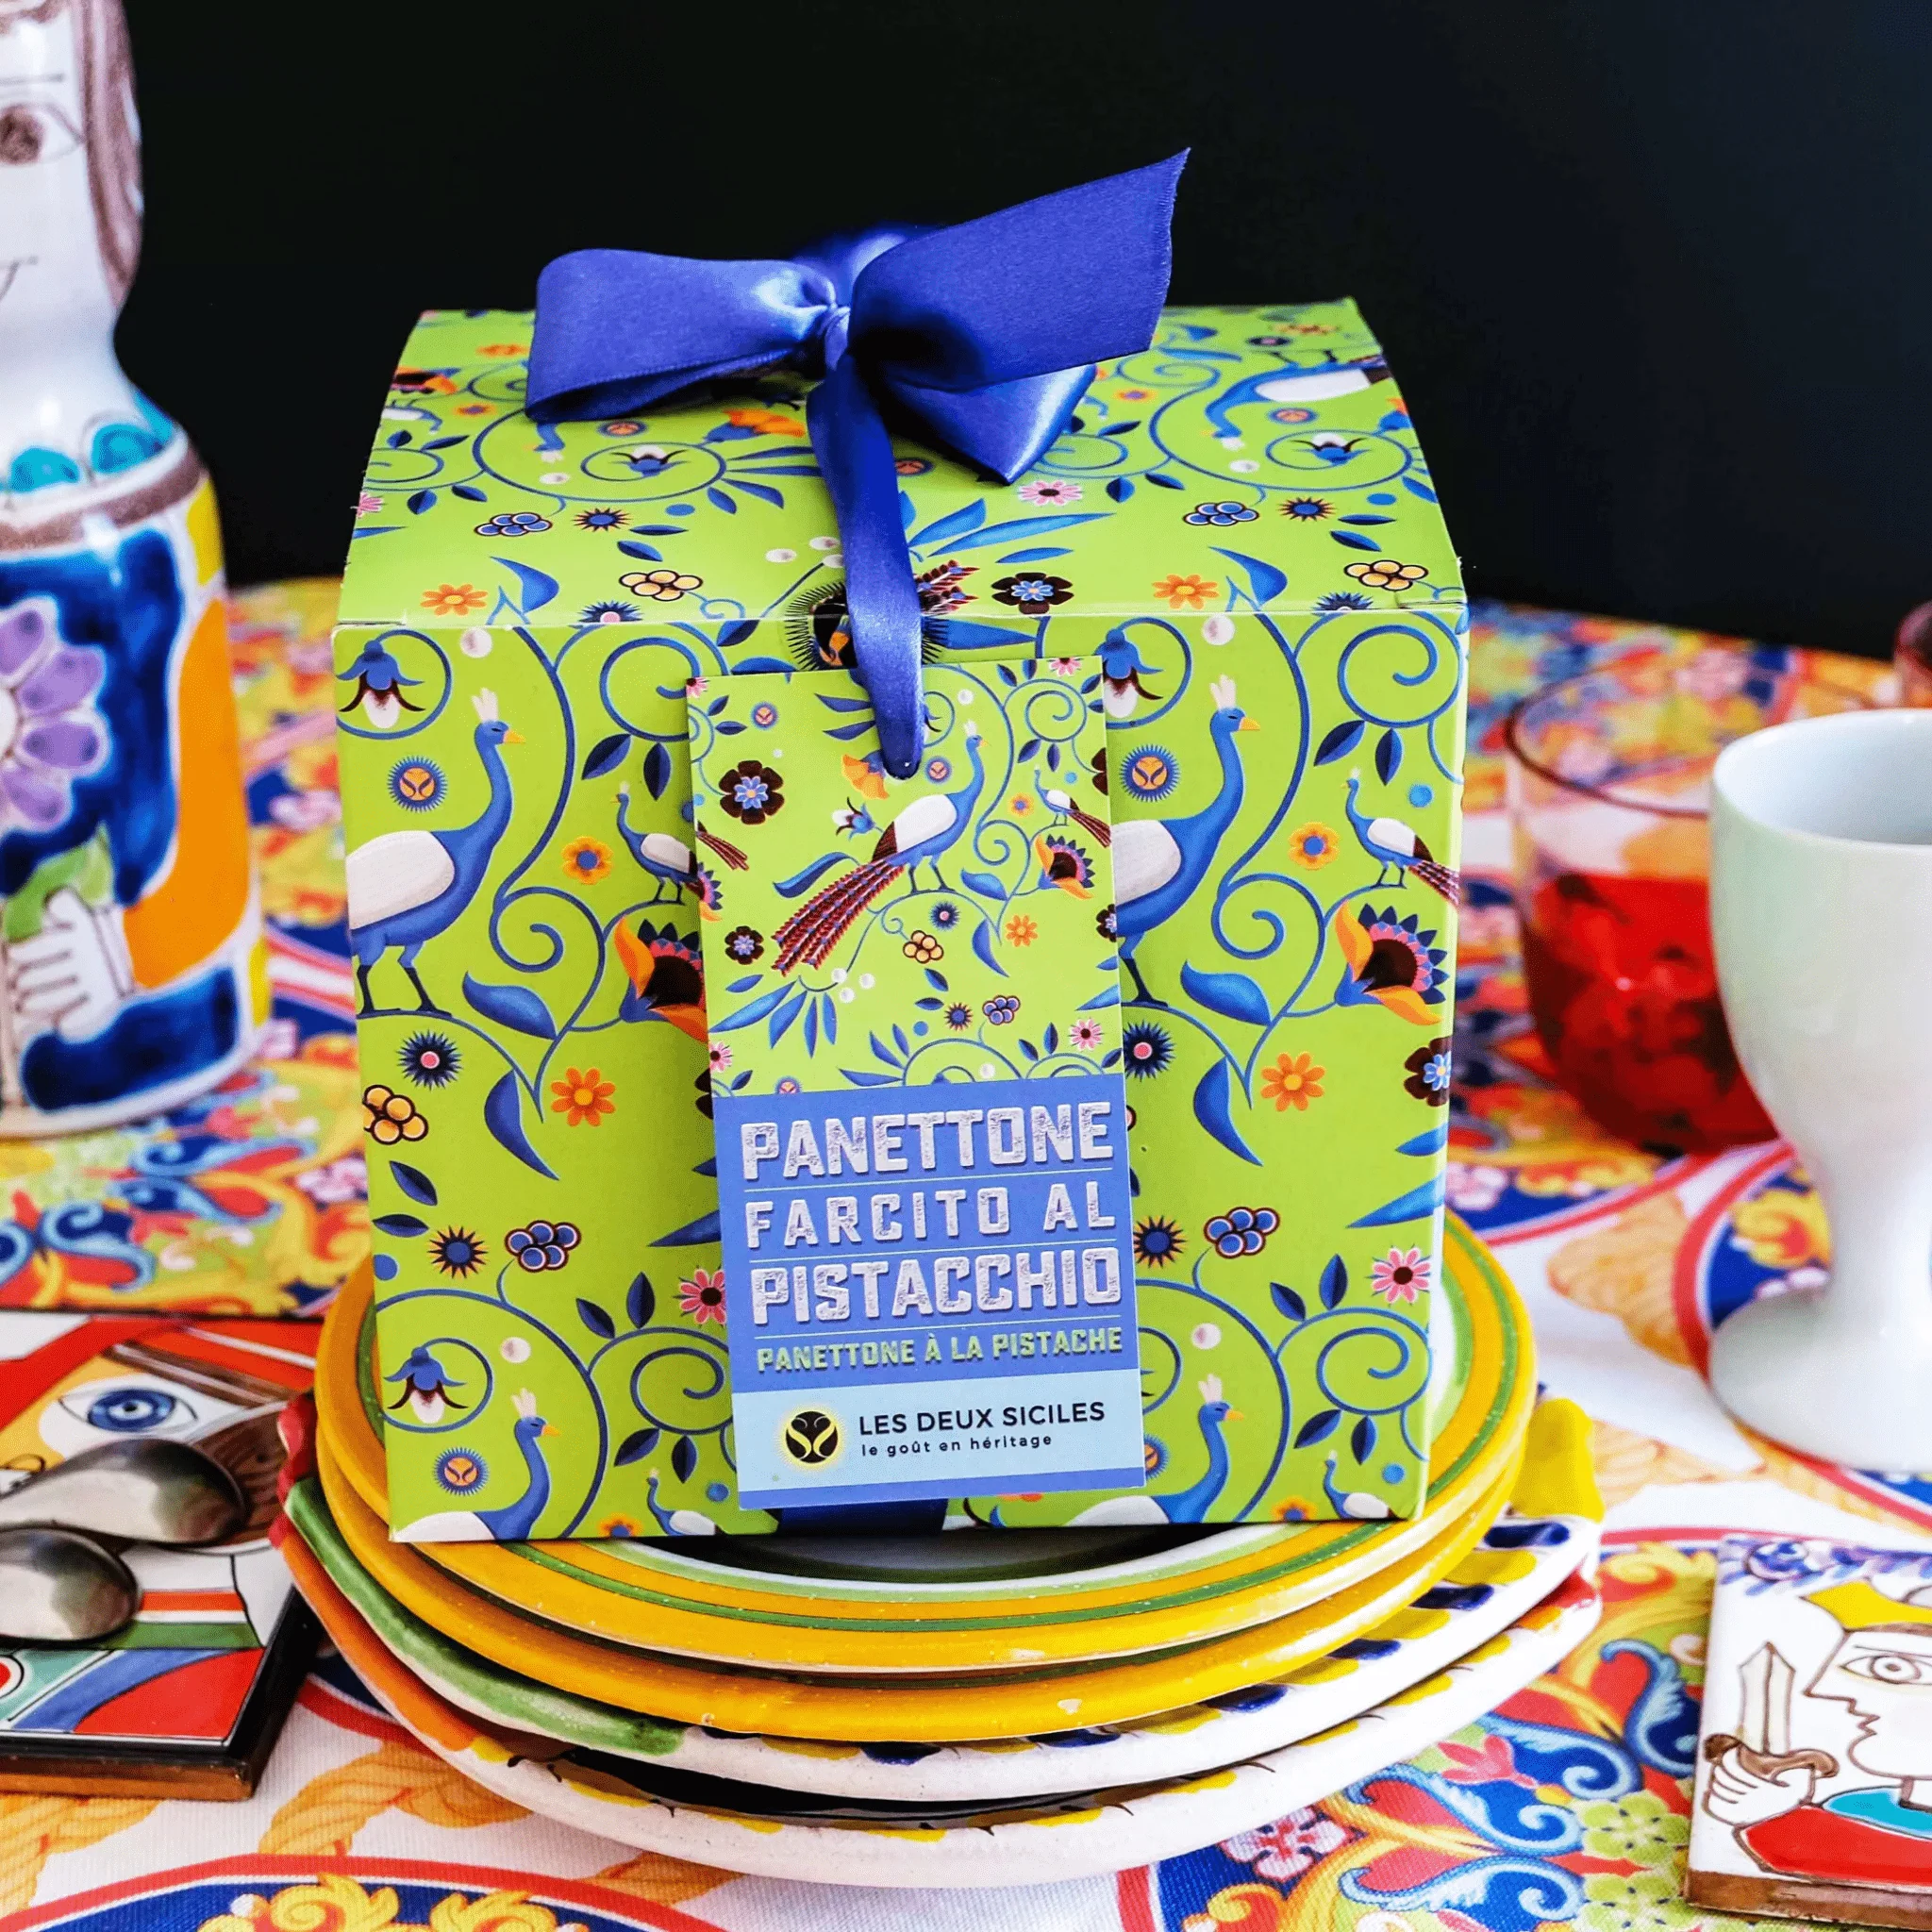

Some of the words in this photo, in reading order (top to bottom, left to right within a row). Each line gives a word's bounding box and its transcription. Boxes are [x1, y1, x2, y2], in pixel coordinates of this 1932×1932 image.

[741, 1101, 1114, 1180] PANETTONE
[745, 1187, 1010, 1248] FARCITO
[1043, 1181, 1116, 1231] AL
[751, 1246, 1122, 1324] PISTACCHIO
[758, 1340, 914, 1372] PANETTONE
[924, 1333, 942, 1361] À
[951, 1336, 984, 1360] LA
[992, 1327, 1123, 1357] PISTACHE
[859, 1414, 907, 1436] LES
[917, 1408, 993, 1432] DEUX
[1003, 1401, 1105, 1426] SICILES
[862, 1442, 877, 1457] le
[888, 1436, 930, 1457] goût
[940, 1440, 960, 1452] en
[970, 1433, 1053, 1451] héritage
